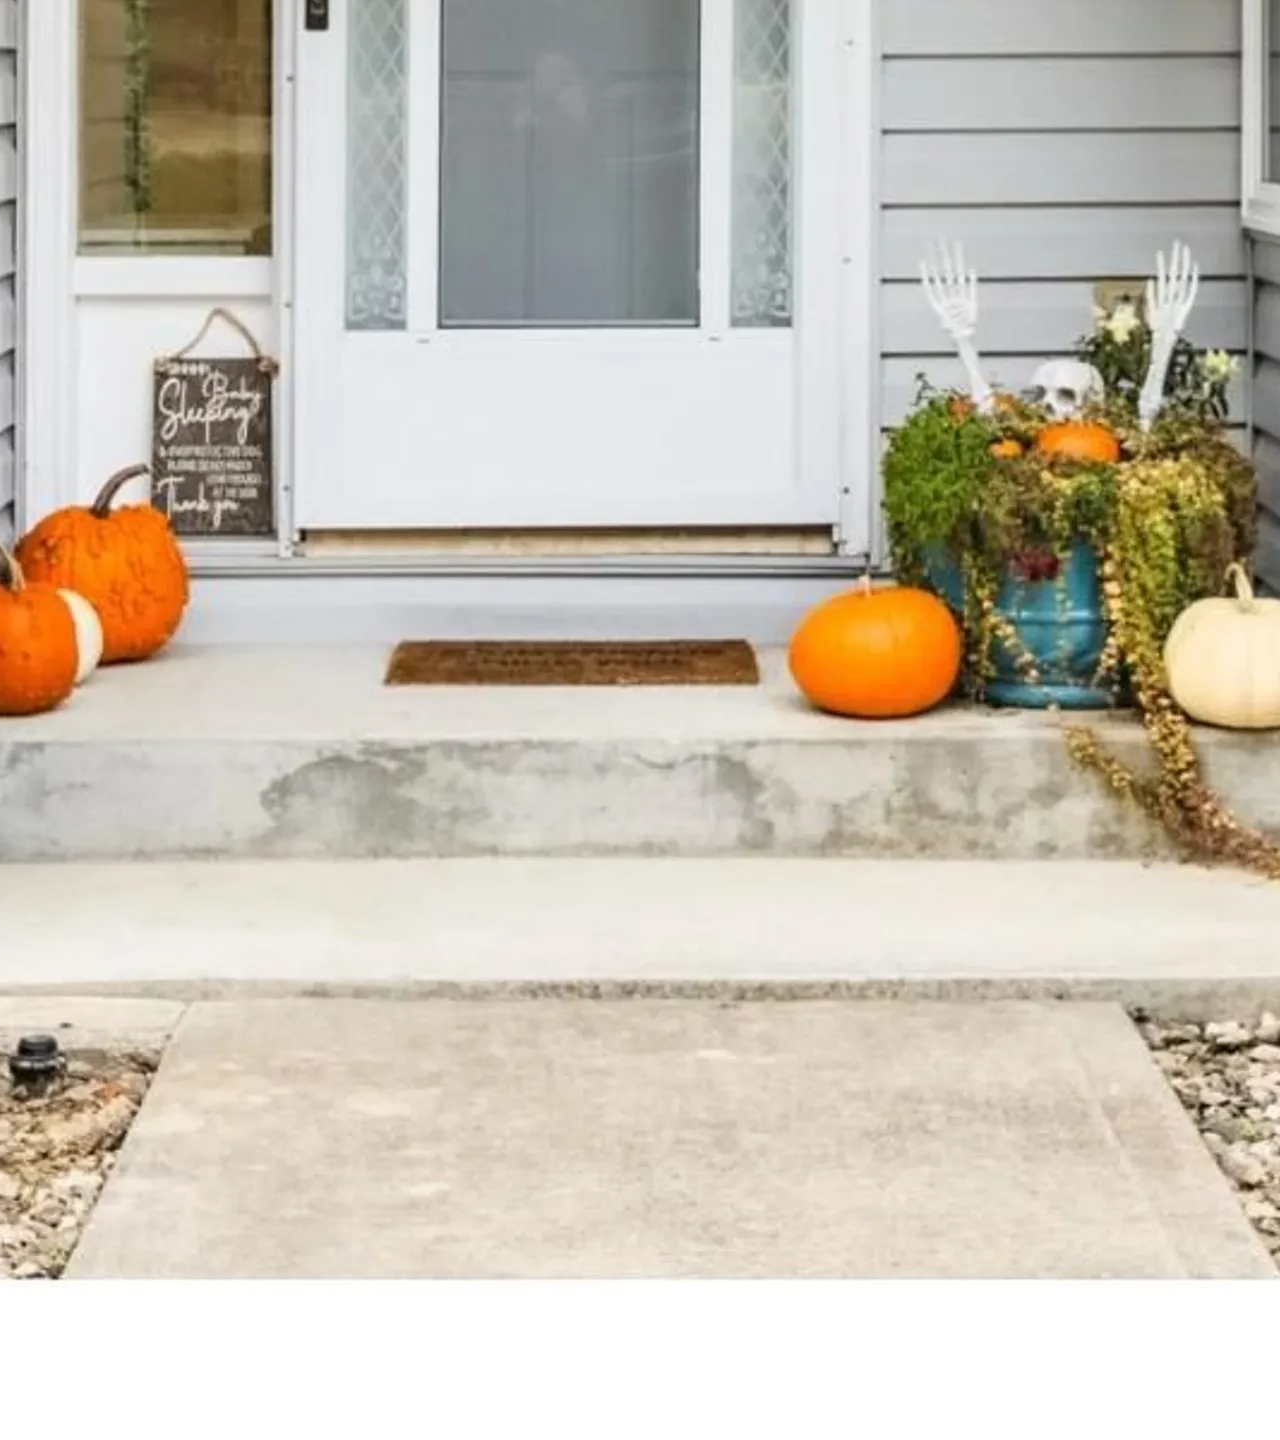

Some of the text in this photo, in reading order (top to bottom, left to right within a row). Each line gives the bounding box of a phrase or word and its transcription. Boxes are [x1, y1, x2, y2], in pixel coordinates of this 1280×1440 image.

[158, 377, 251, 445] Sleeping
[202, 371, 262, 417] Baby
[157, 476, 209, 520] Thank
